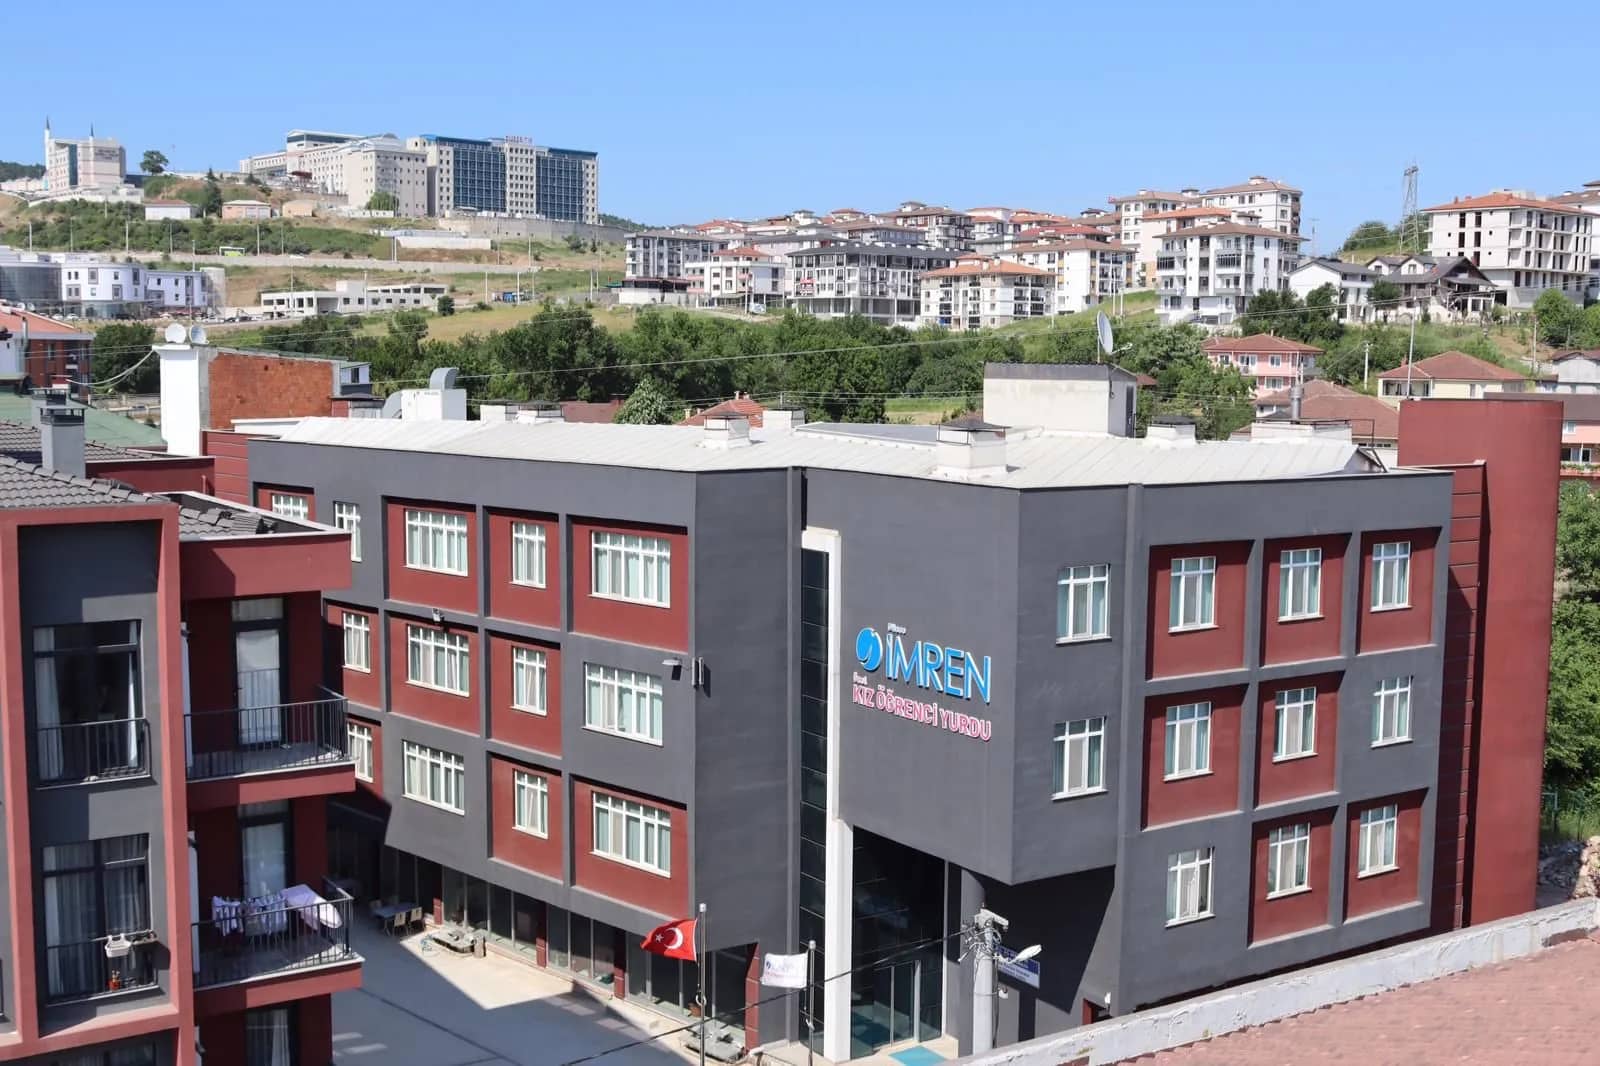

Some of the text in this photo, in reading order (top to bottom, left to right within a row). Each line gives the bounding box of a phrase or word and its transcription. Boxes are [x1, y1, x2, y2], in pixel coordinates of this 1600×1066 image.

[852, 684, 992, 741] KIZ ÖĞRENCİ YURDU
